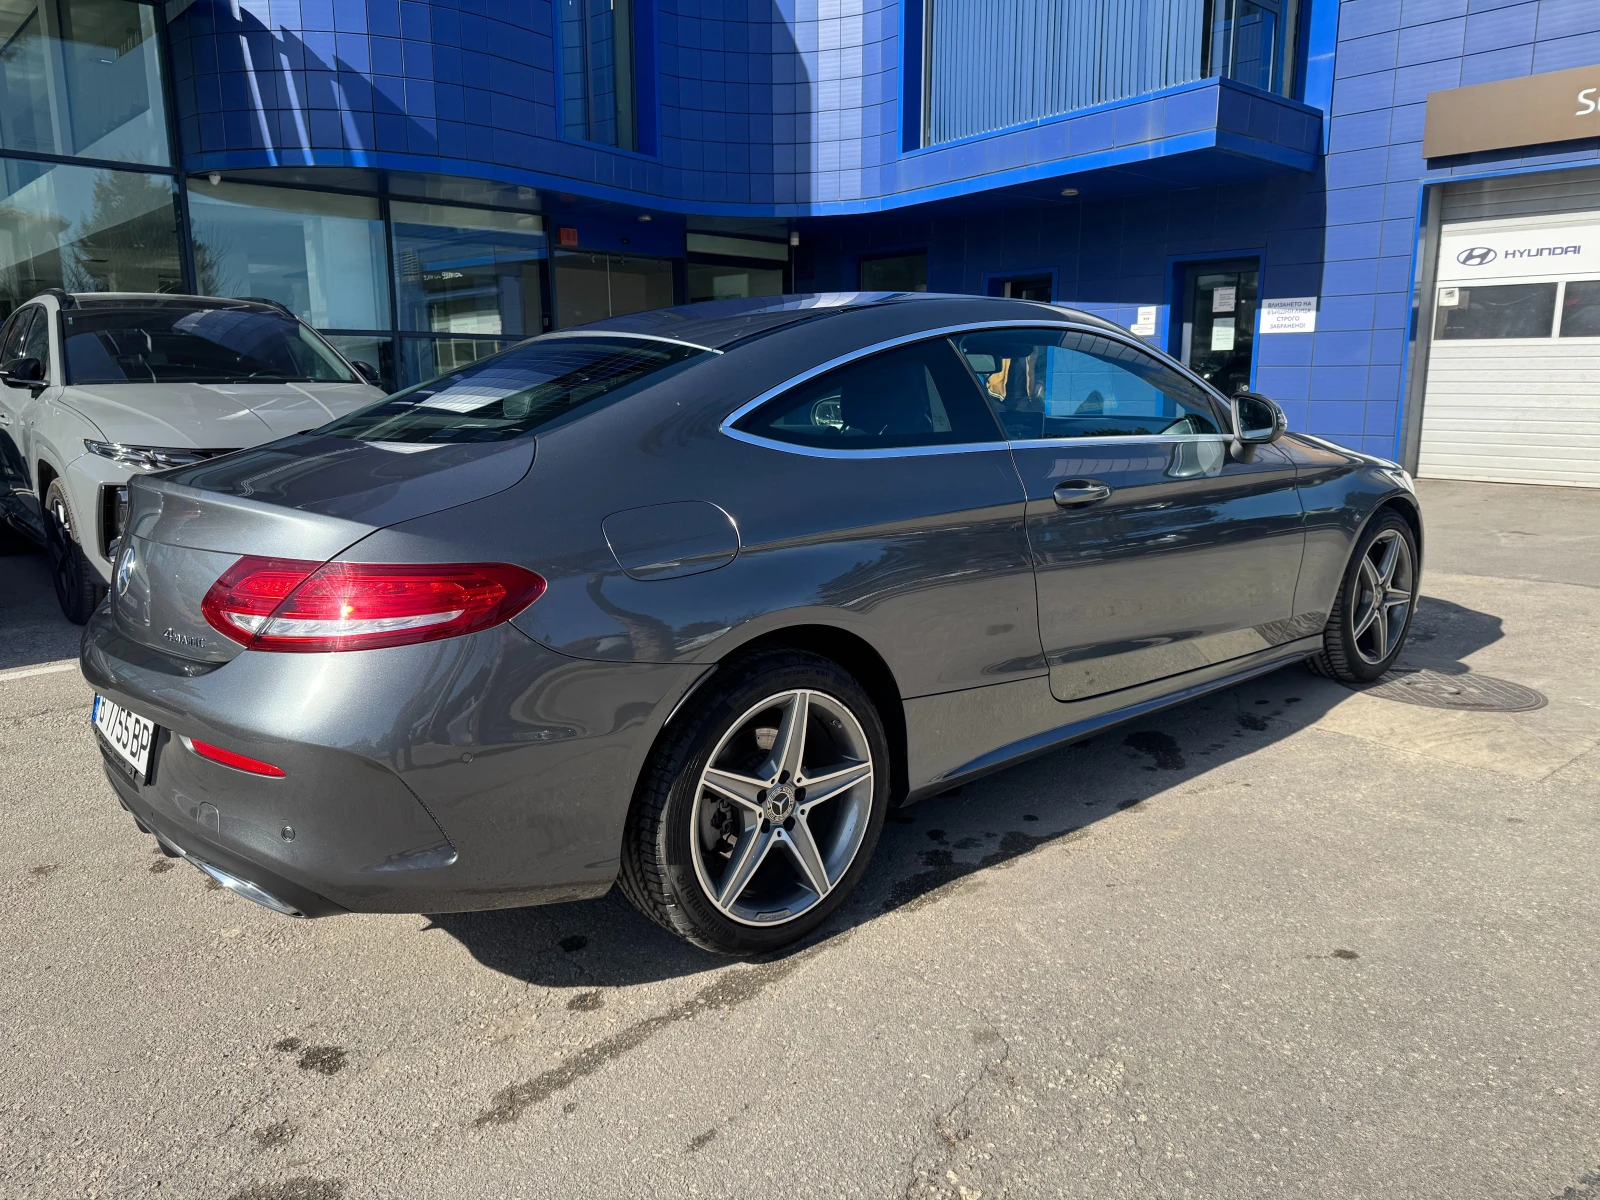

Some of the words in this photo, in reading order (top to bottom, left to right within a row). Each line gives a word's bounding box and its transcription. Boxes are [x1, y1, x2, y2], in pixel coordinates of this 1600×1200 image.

[1574, 88, 1600, 116] S
[1504, 245, 1581, 259] HYUNDAI
[1269, 322, 1306, 330] ЗАБРАНЕНО!
